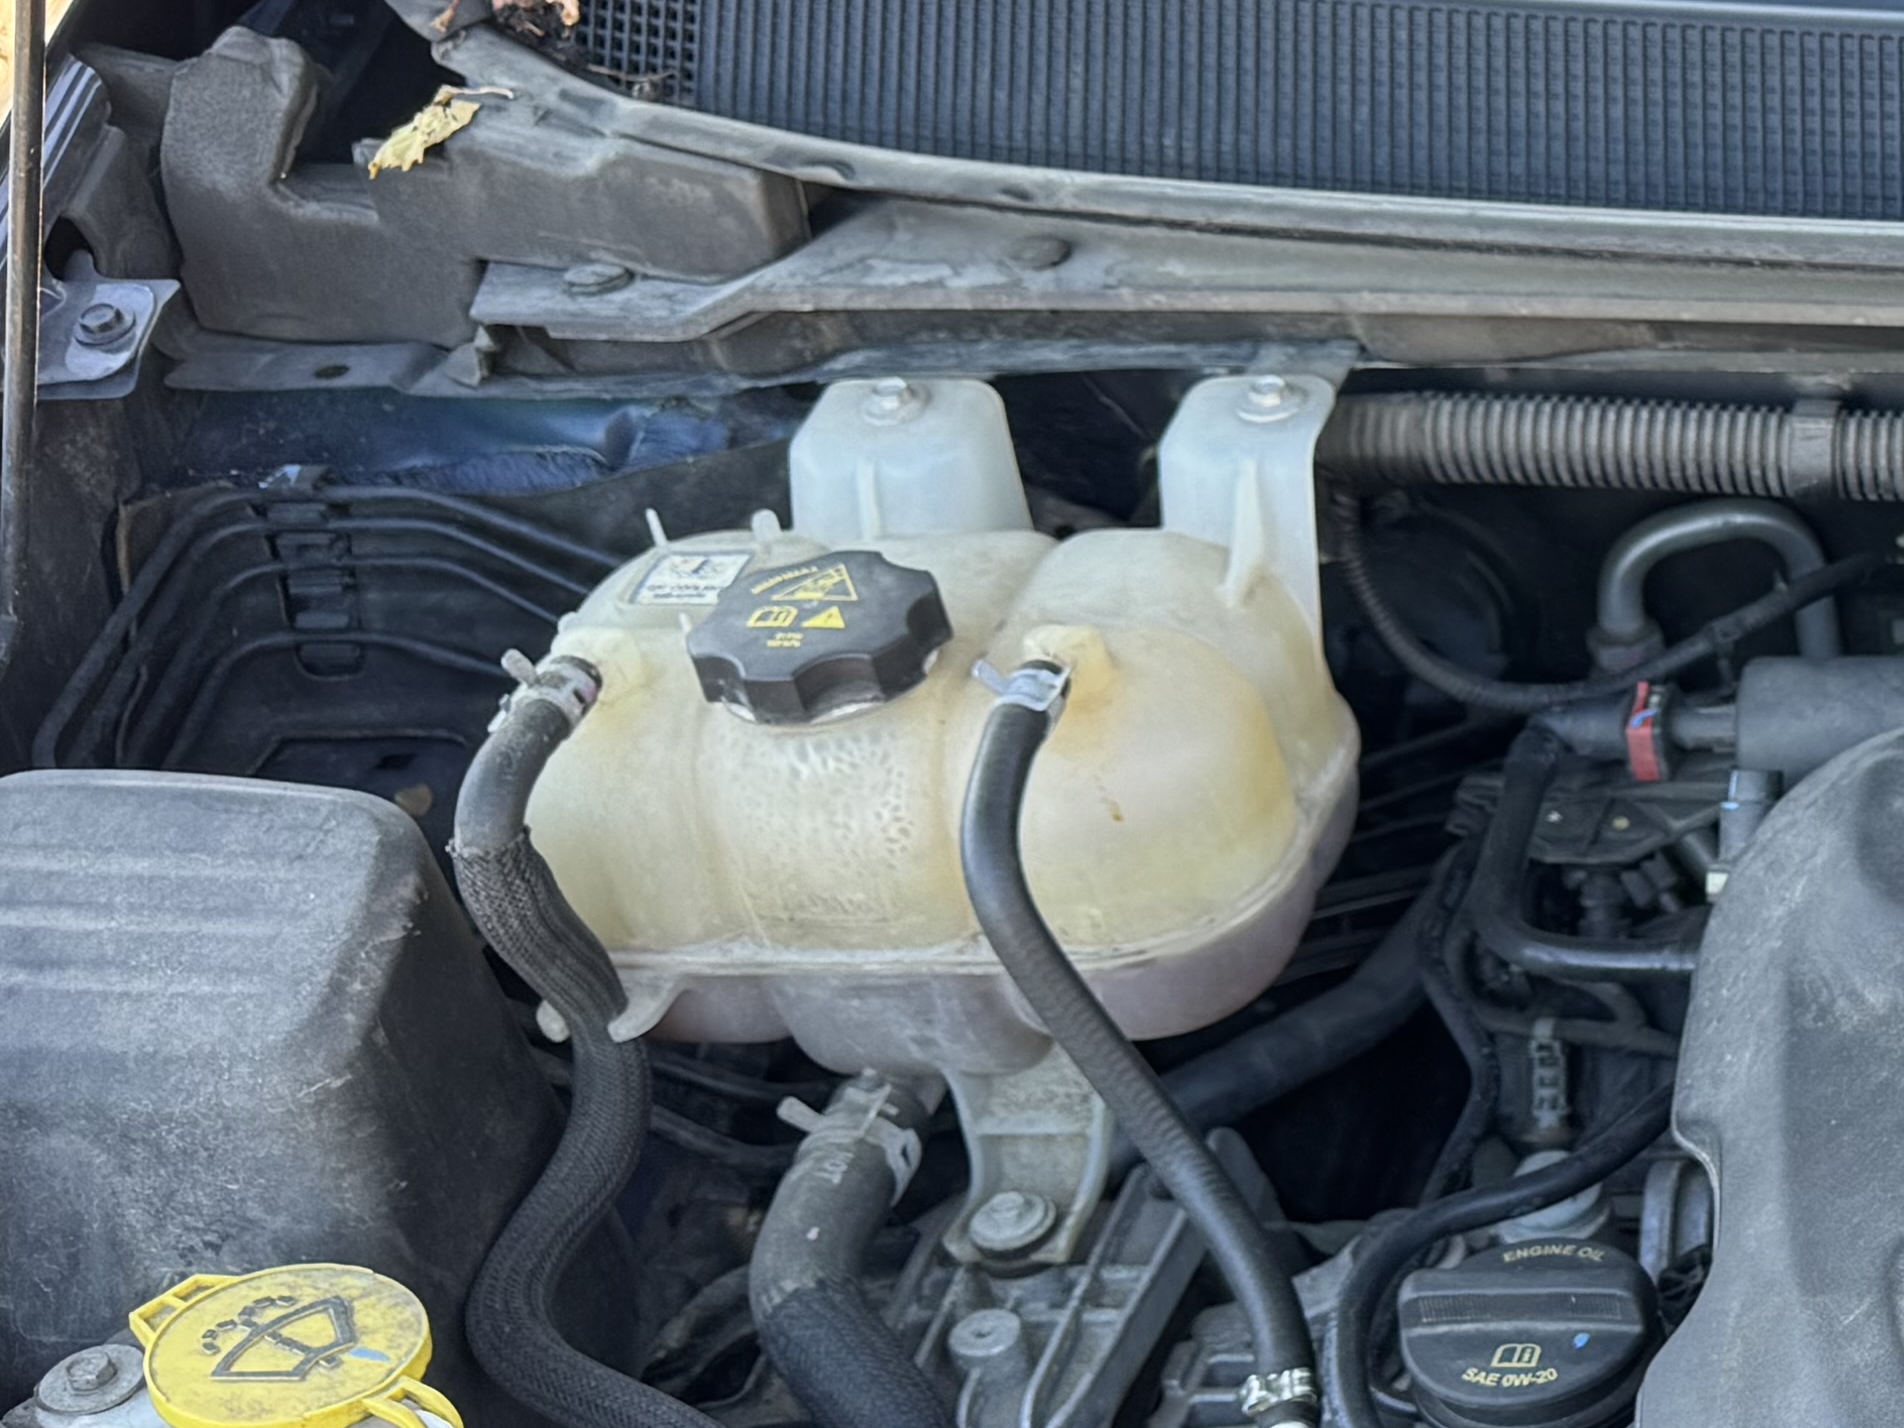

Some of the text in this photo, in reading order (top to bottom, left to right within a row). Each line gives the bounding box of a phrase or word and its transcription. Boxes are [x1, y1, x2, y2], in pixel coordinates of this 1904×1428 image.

[1503, 1244, 1605, 1263] ENGINE OIL
[1462, 1367, 1558, 1388] SAE 0W-20
